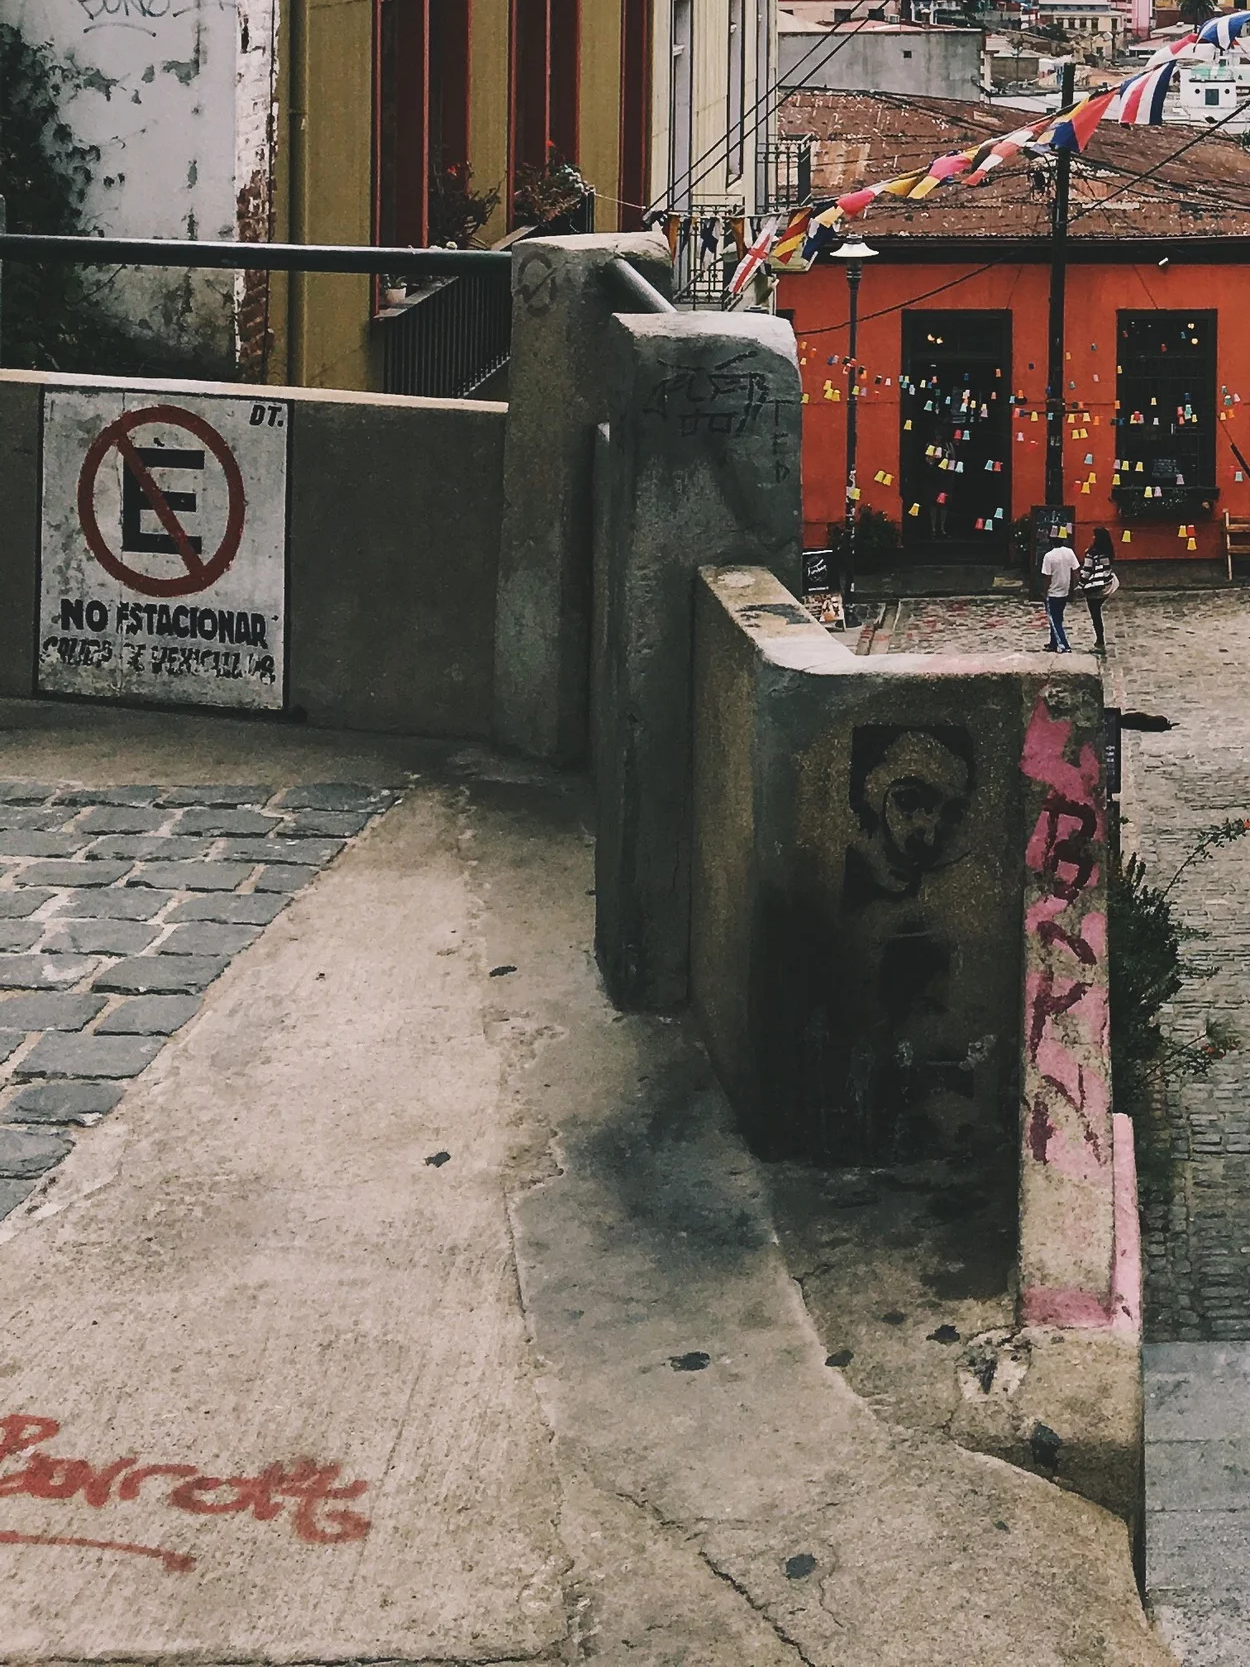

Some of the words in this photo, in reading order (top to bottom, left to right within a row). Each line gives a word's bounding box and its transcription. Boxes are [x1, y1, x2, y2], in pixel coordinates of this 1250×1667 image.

[122, 446, 206, 556] E
[60, 598, 109, 633] NO
[116, 600, 269, 650] ESTACIONAR
